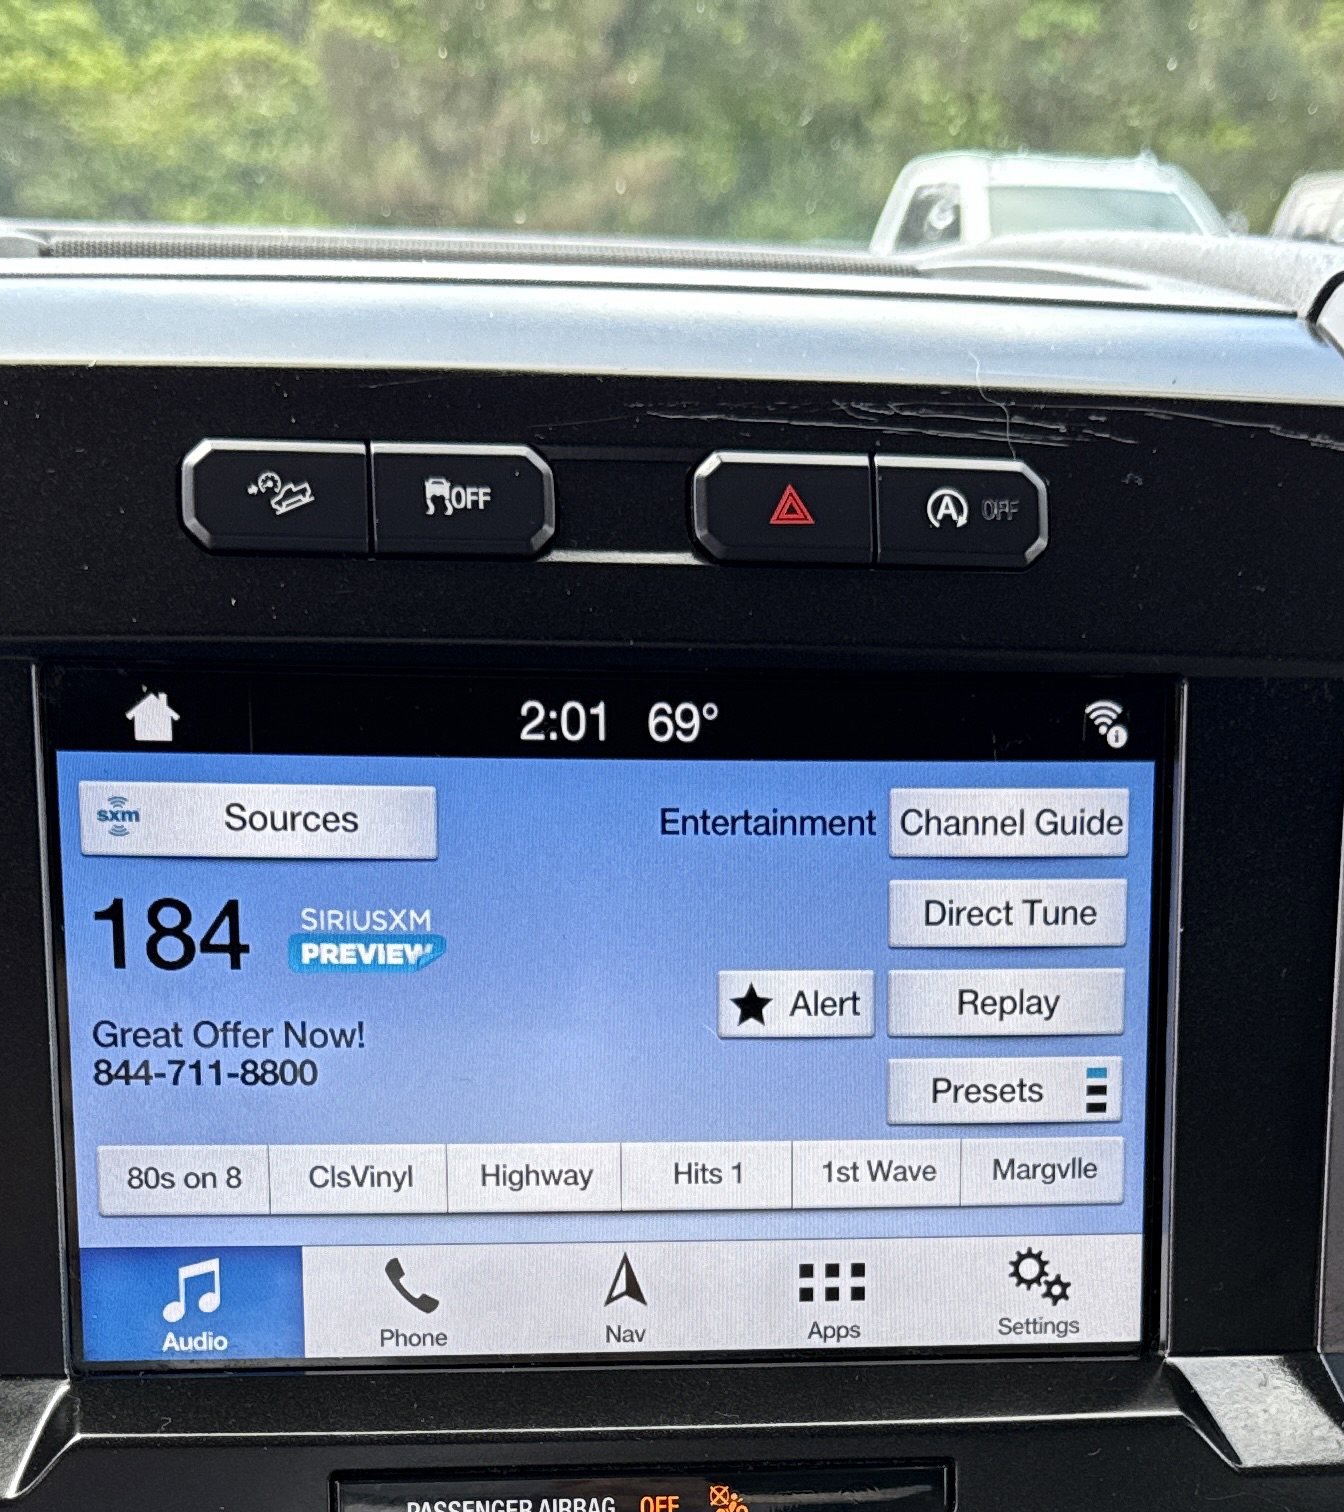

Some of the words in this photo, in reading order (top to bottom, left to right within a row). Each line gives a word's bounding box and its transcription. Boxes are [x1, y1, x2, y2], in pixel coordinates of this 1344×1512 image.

[452, 486, 491, 511] OFF
[981, 500, 1020, 521] OFF
[520, 701, 607, 741] 2:01
[648, 702, 718, 743] 69°
[96, 809, 140, 823] sxm
[225, 803, 358, 833] Sources
[660, 808, 876, 836] Entertainment
[900, 808, 1025, 836] Channel
[1034, 808, 1123, 836] Guide
[301, 908, 431, 931] SIRIUSXM
[924, 900, 1013, 926] Direct
[1022, 900, 1097, 926] Tune
[93, 897, 250, 970] 184
[301, 943, 433, 965] PREVIEW
[790, 990, 861, 1016] Alert
[958, 989, 1060, 1020] Replay
[93, 1021, 182, 1049] Great
[193, 1020, 273, 1049] Offer
[284, 1021, 364, 1049] Now!
[93, 1059, 317, 1087] 844-711-8800
[932, 1077, 1044, 1103] Presets
[127, 1167, 175, 1189] 80s
[184, 1172, 217, 1189] on
[227, 1167, 241, 1189] 8
[309, 1165, 413, 1191] ClsVinyl
[481, 1165, 593, 1191] Highway
[674, 1162, 723, 1184] Hits
[732, 1162, 742, 1184] 1
[823, 1160, 859, 1182] 1st
[867, 1160, 937, 1182] Wave
[993, 1158, 1097, 1184] Margvlle
[380, 1328, 447, 1347] Phone
[605, 1325, 645, 1343] Nav
[807, 1320, 861, 1340] Apps
[998, 1317, 1080, 1338] Settings
[162, 1332, 228, 1351] Audio
